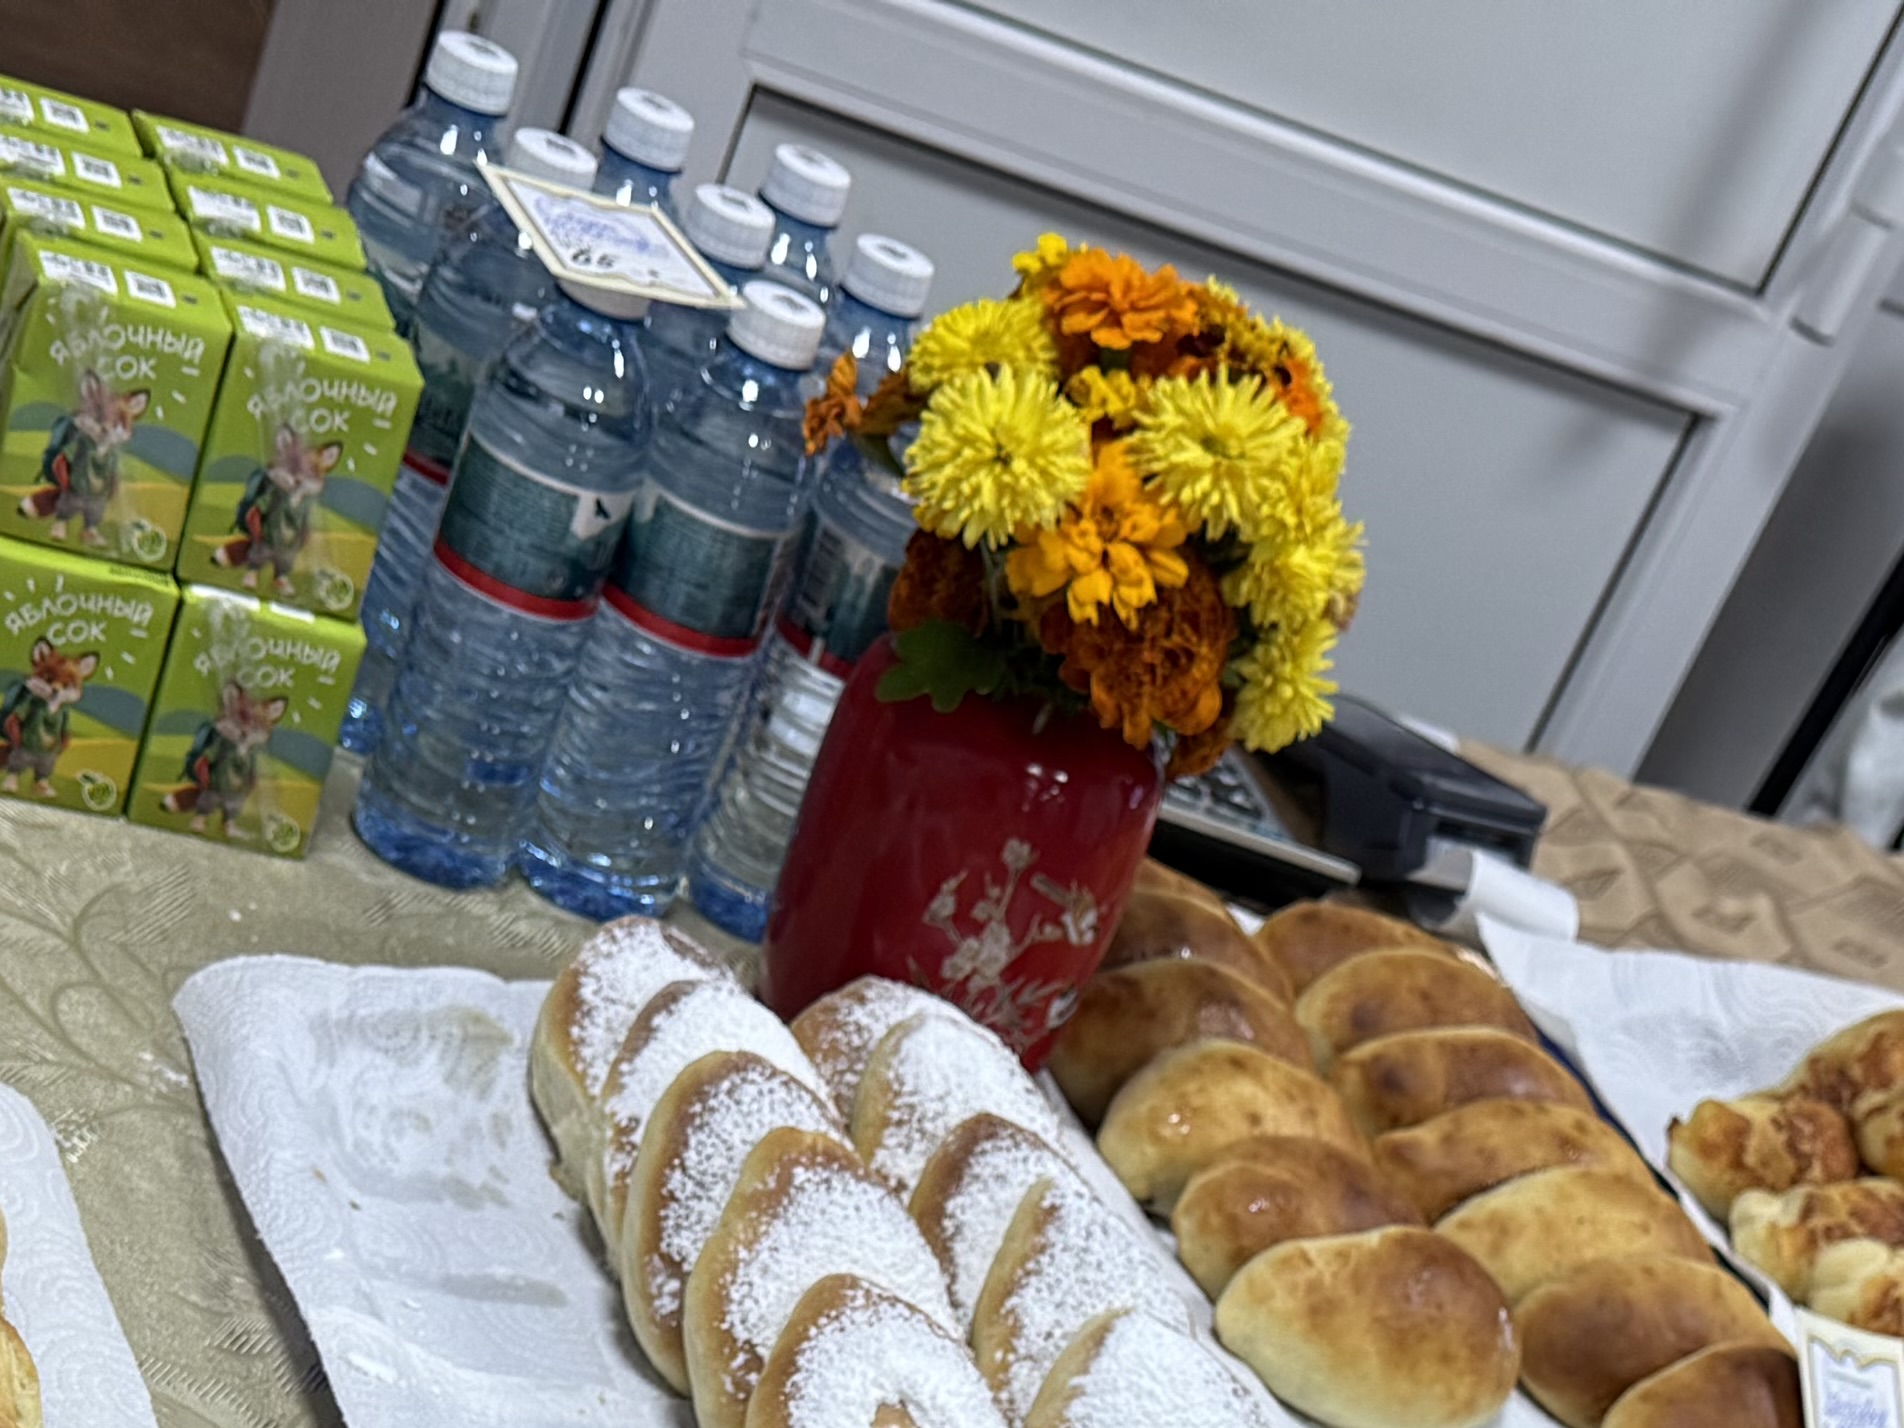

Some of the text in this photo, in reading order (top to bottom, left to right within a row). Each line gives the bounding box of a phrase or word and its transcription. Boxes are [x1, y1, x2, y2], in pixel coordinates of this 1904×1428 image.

[49, 324, 206, 365] ЯБЛОЧНЫЙ
[98, 355, 157, 382] СОК
[4, 593, 155, 636] ЯБЛОЧНЫЙ
[46, 619, 108, 646] СОК
[237, 661, 297, 690] СОК
